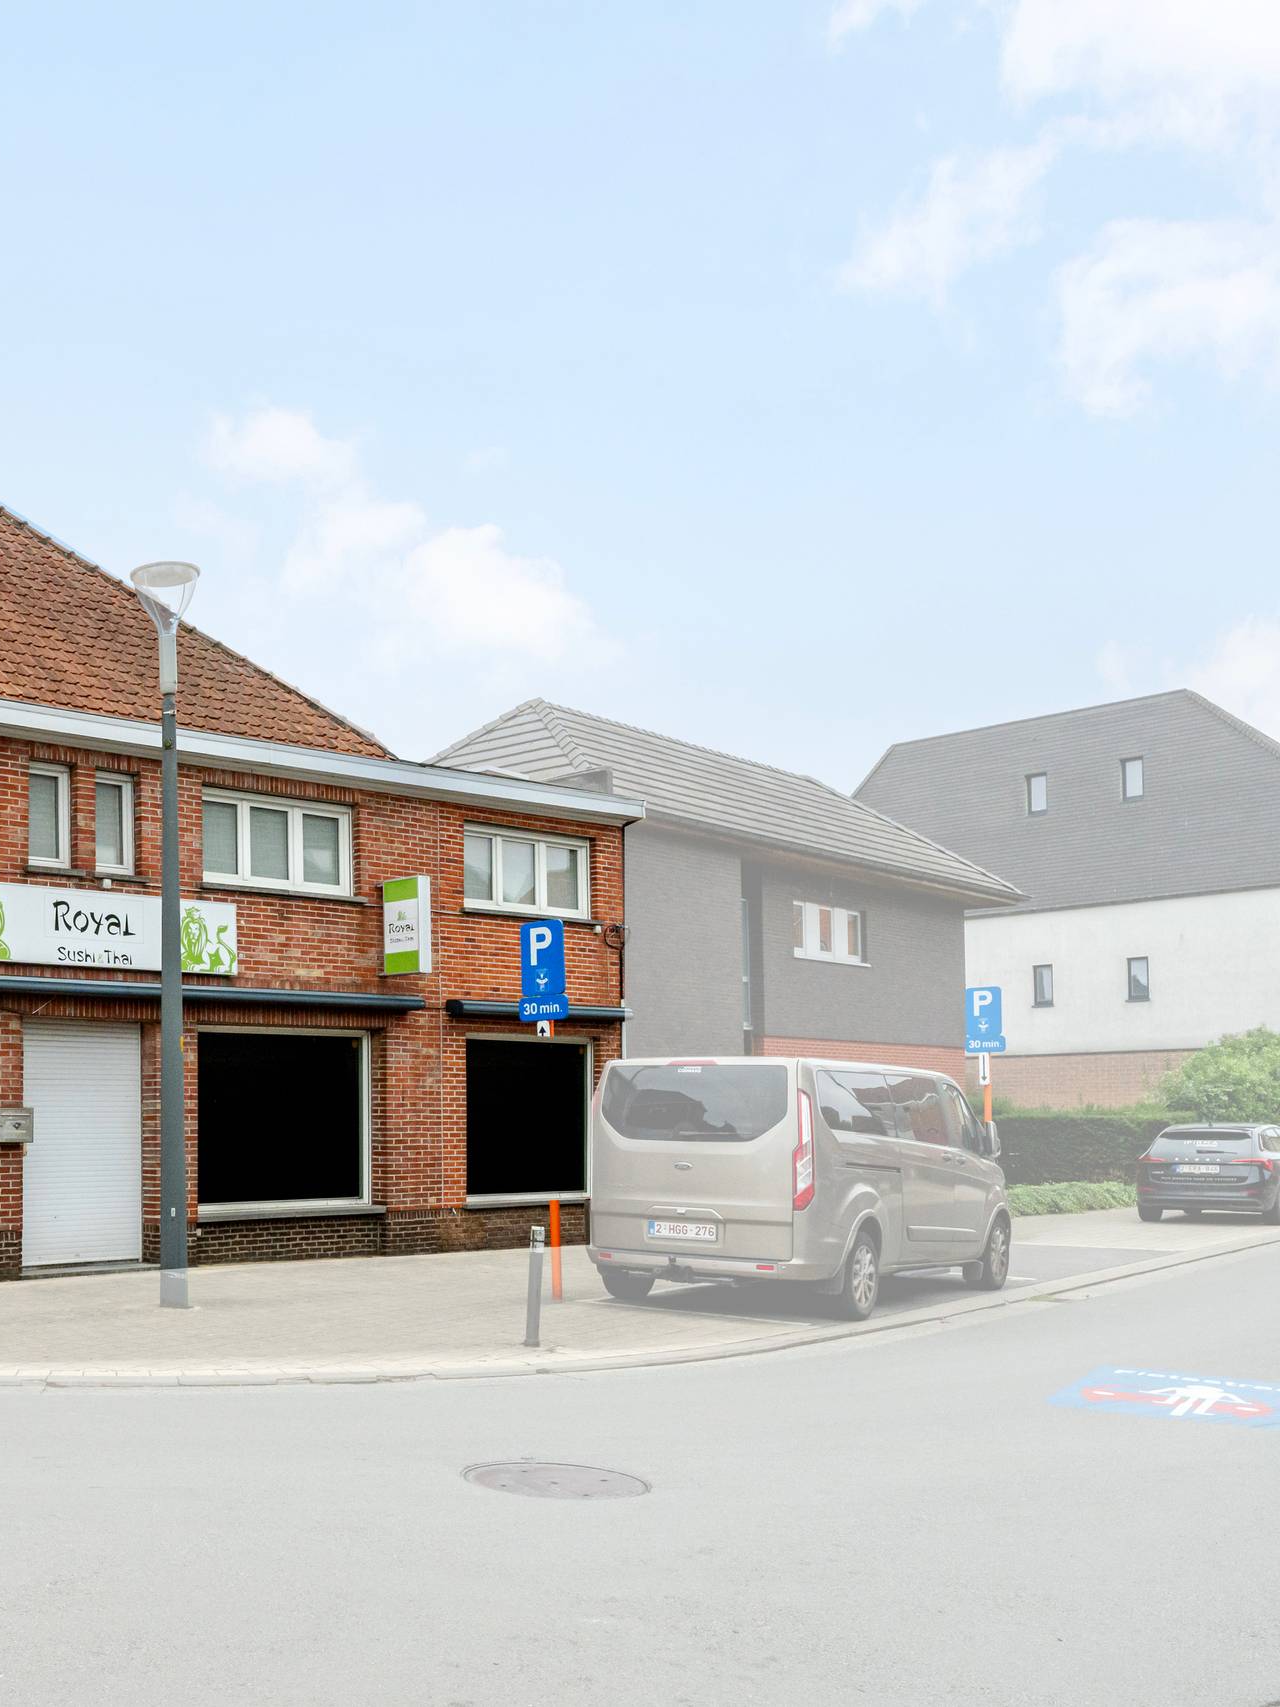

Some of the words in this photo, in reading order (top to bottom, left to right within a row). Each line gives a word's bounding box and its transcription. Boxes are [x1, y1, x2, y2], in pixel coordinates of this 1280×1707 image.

[57, 946, 96, 964] Sushi
[103, 949, 133, 966] Thai
[529, 926, 553, 966] P
[523, 1002, 538, 1015] 30
[539, 1001, 563, 1015] min.
[973, 990, 993, 1017] P
[968, 1040, 981, 1049] 30
